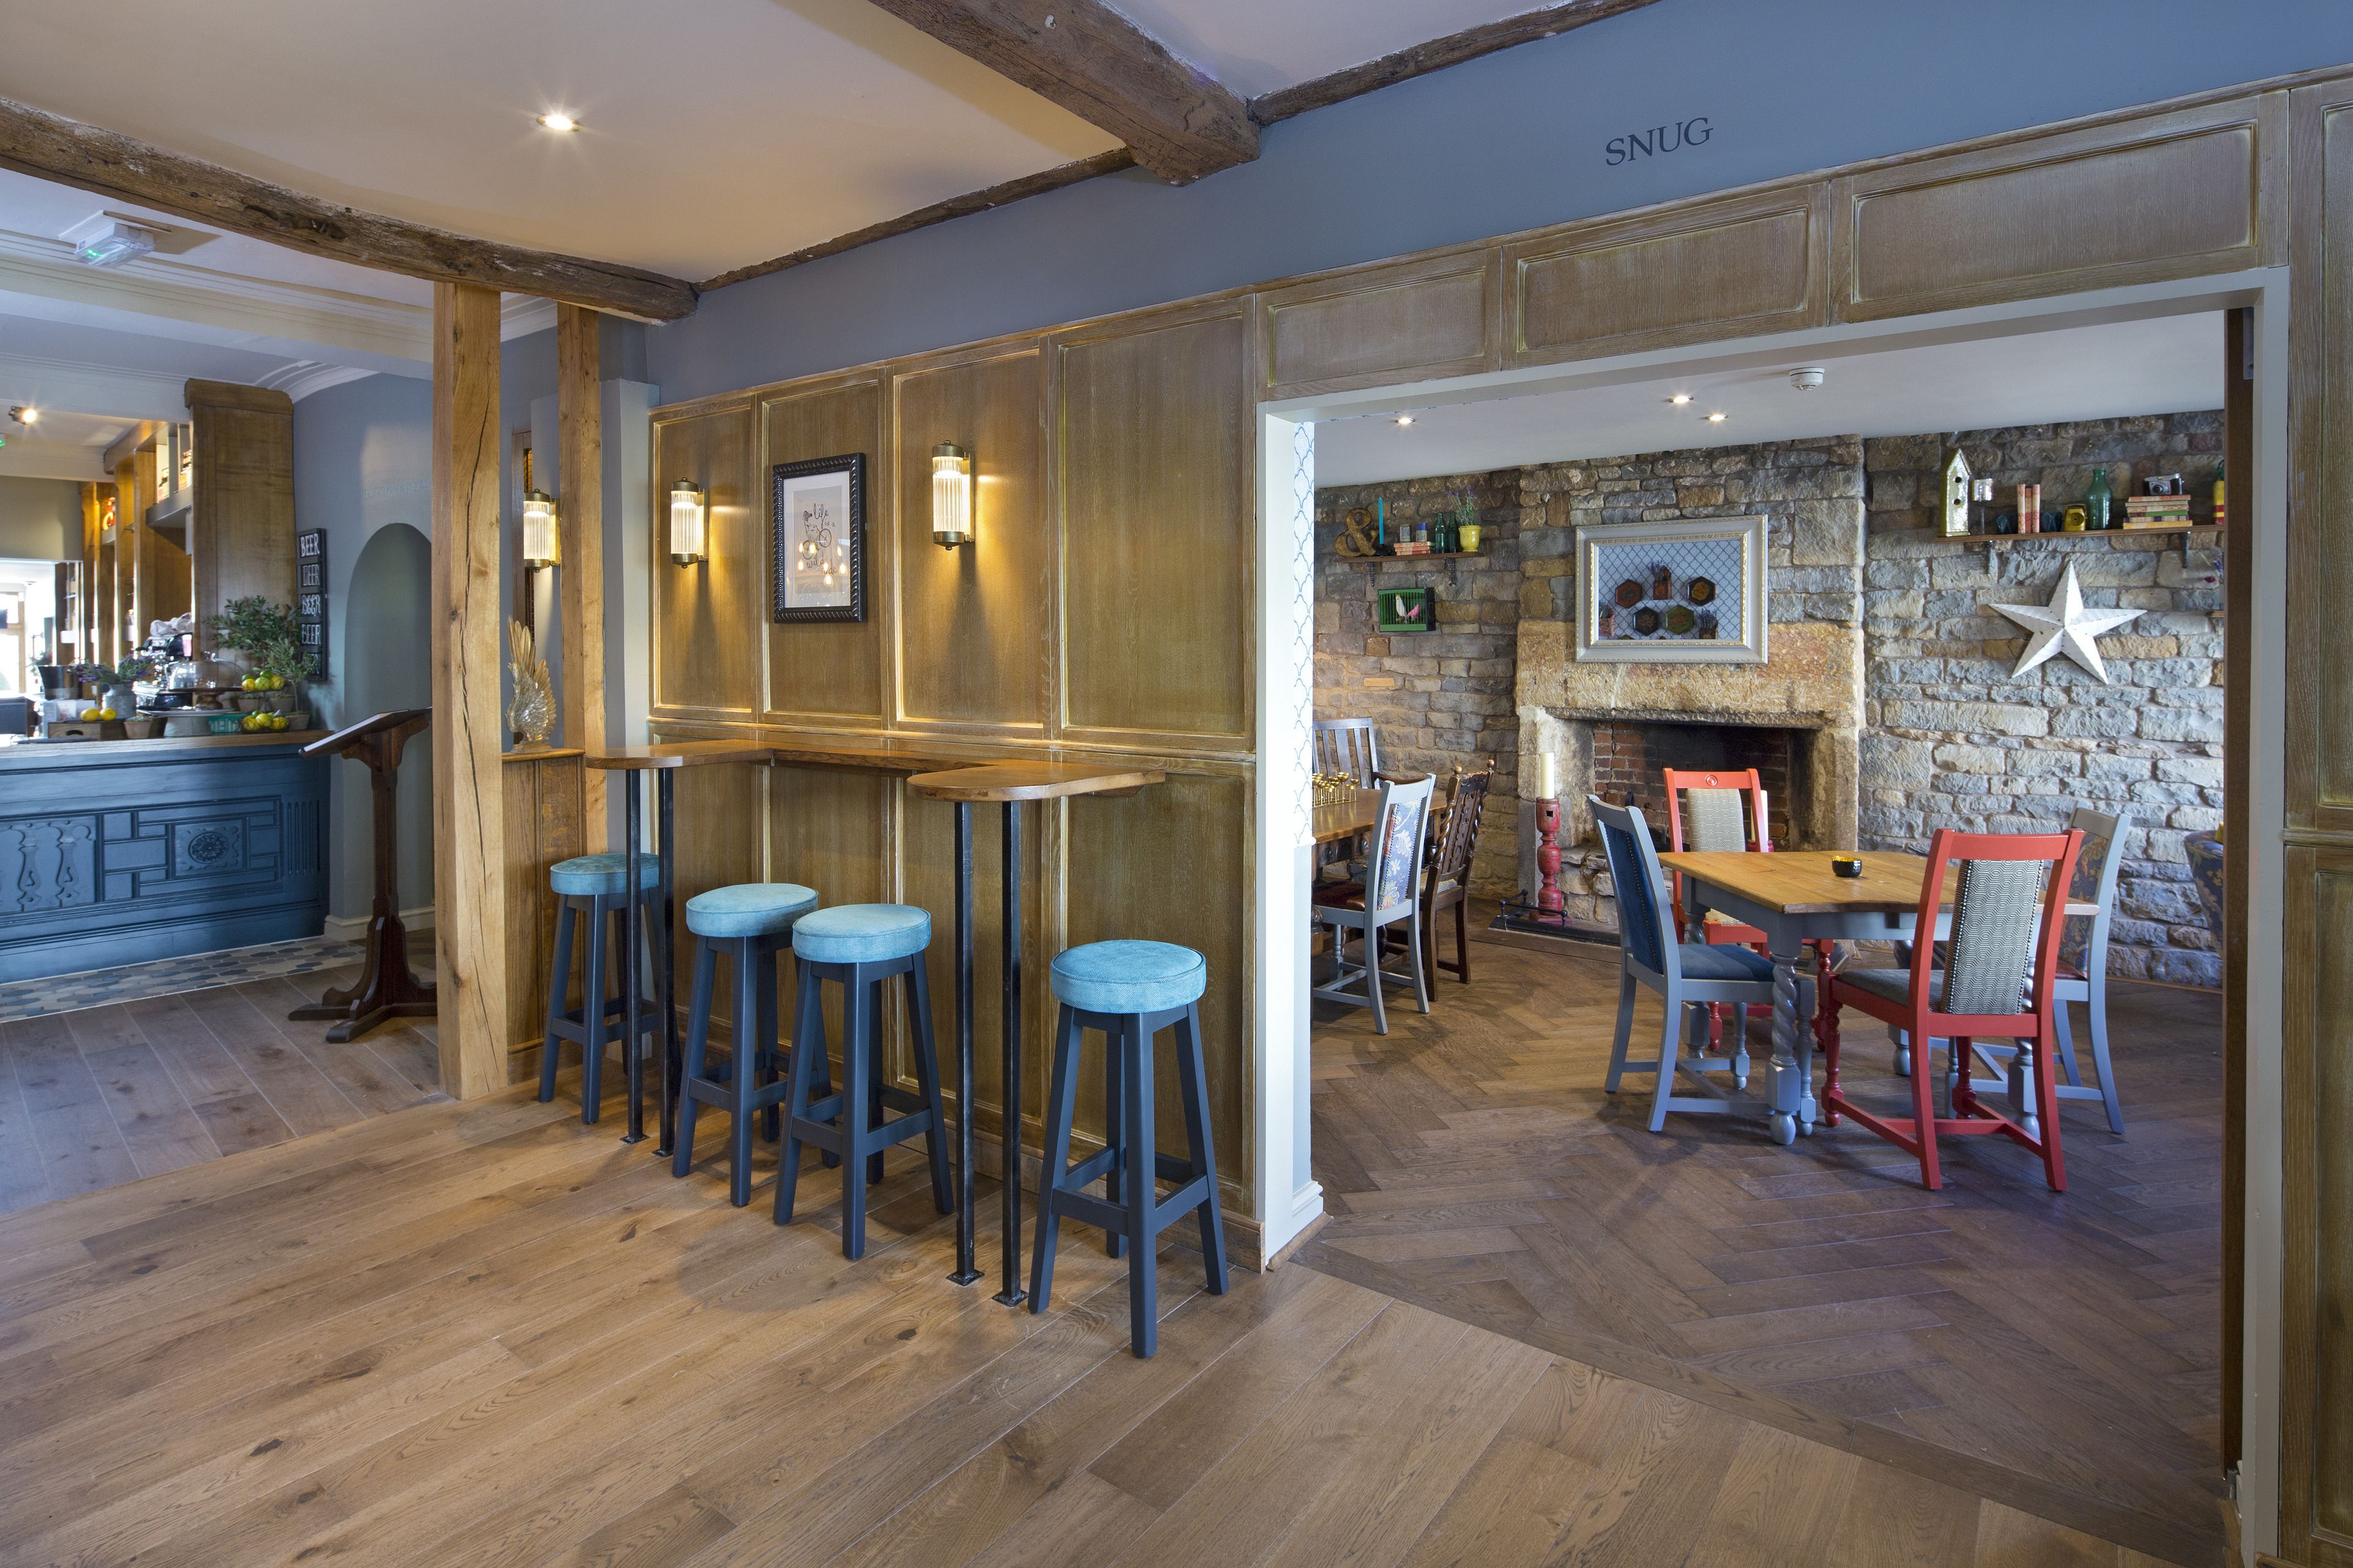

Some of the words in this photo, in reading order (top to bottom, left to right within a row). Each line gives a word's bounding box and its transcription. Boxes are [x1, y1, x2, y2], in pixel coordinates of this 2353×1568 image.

[1605, 118, 1714, 166] SNUG
[813, 503, 829, 529] life
[300, 533, 320, 557] BEER
[806, 551, 824, 568] wild
[301, 594, 320, 617] BEER
[301, 624, 321, 645] BEER
